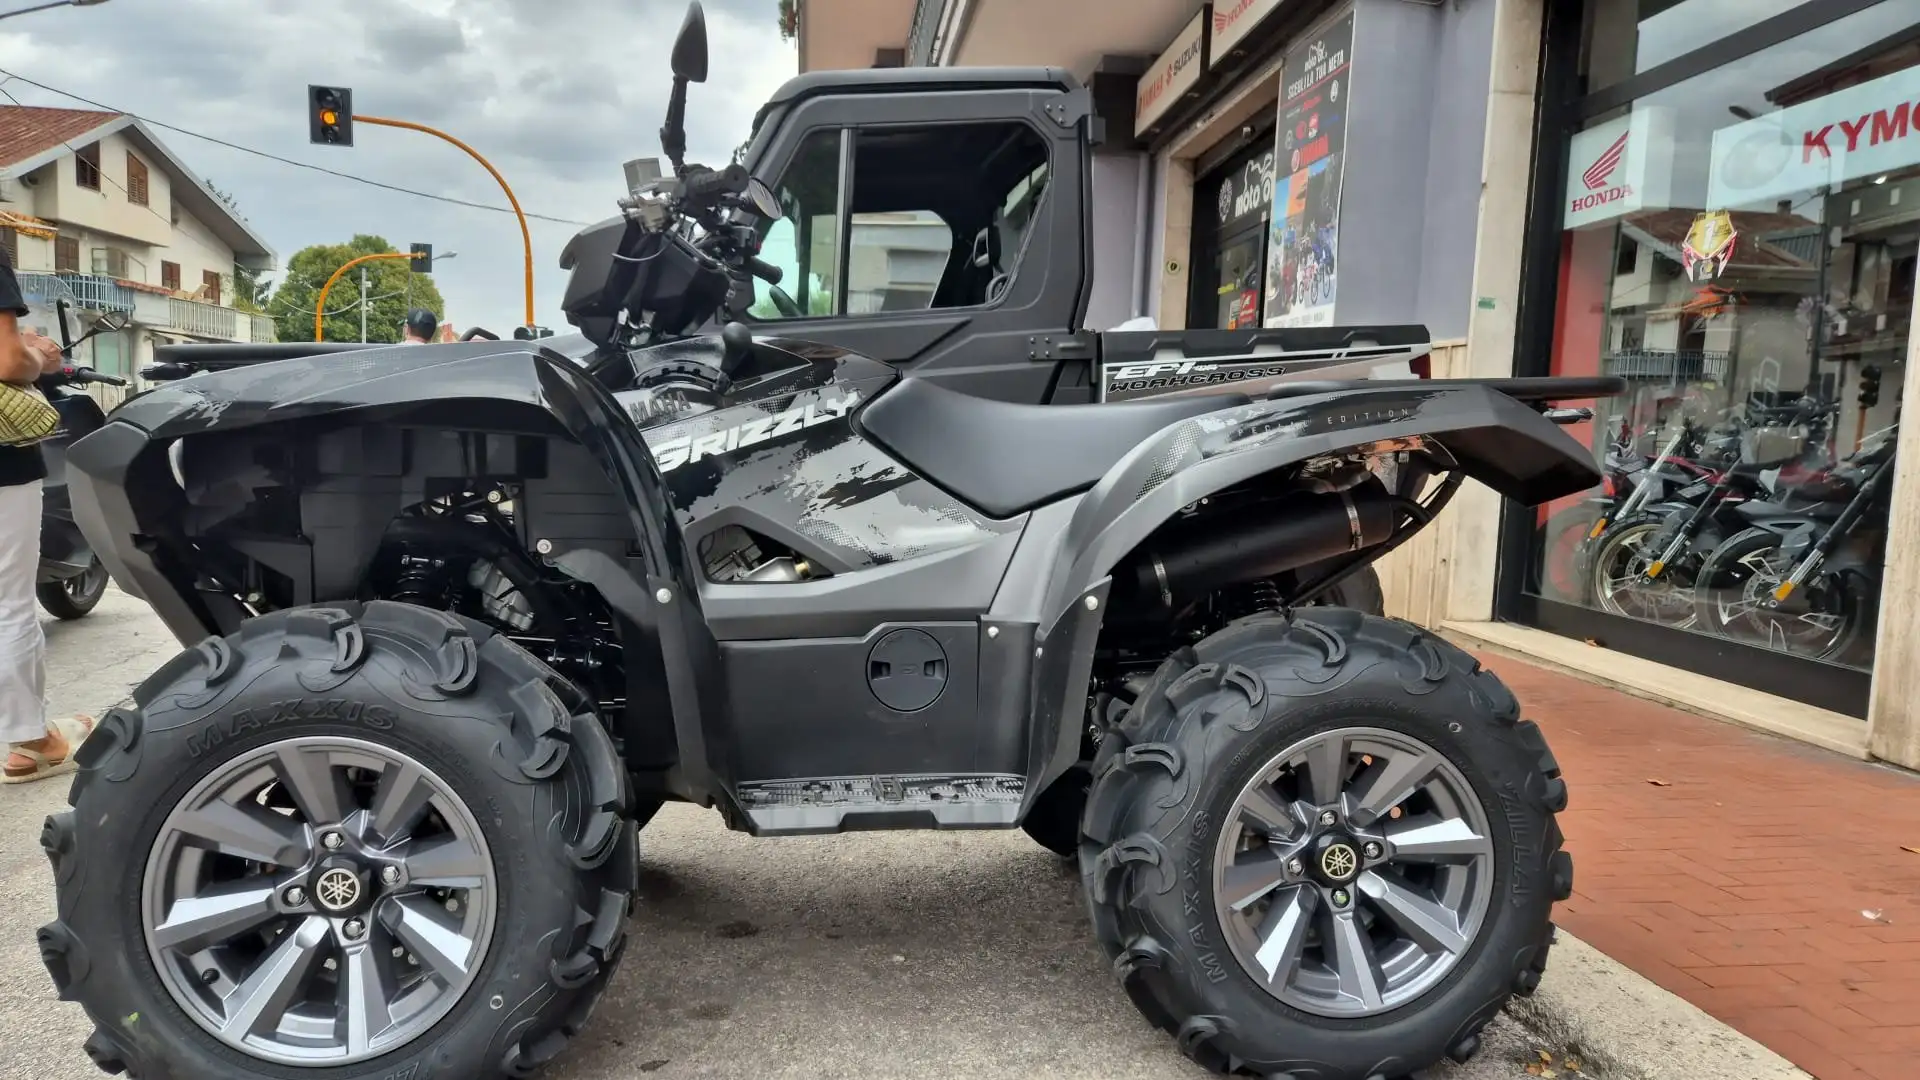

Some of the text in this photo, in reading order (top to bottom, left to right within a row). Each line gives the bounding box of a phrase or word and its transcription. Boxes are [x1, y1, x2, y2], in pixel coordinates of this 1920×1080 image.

[1173, 34, 1201, 76] SUZUKI
[1235, 184, 1260, 218] moto
[1571, 184, 1633, 213] HONDA
[629, 390, 692, 423] MAHA
[1327, 408, 1410, 424] EDITION
[650, 390, 861, 473] GRIZZLY
[184, 698, 399, 758] MAXXIS
[1182, 810, 1228, 984] MAXXIS
